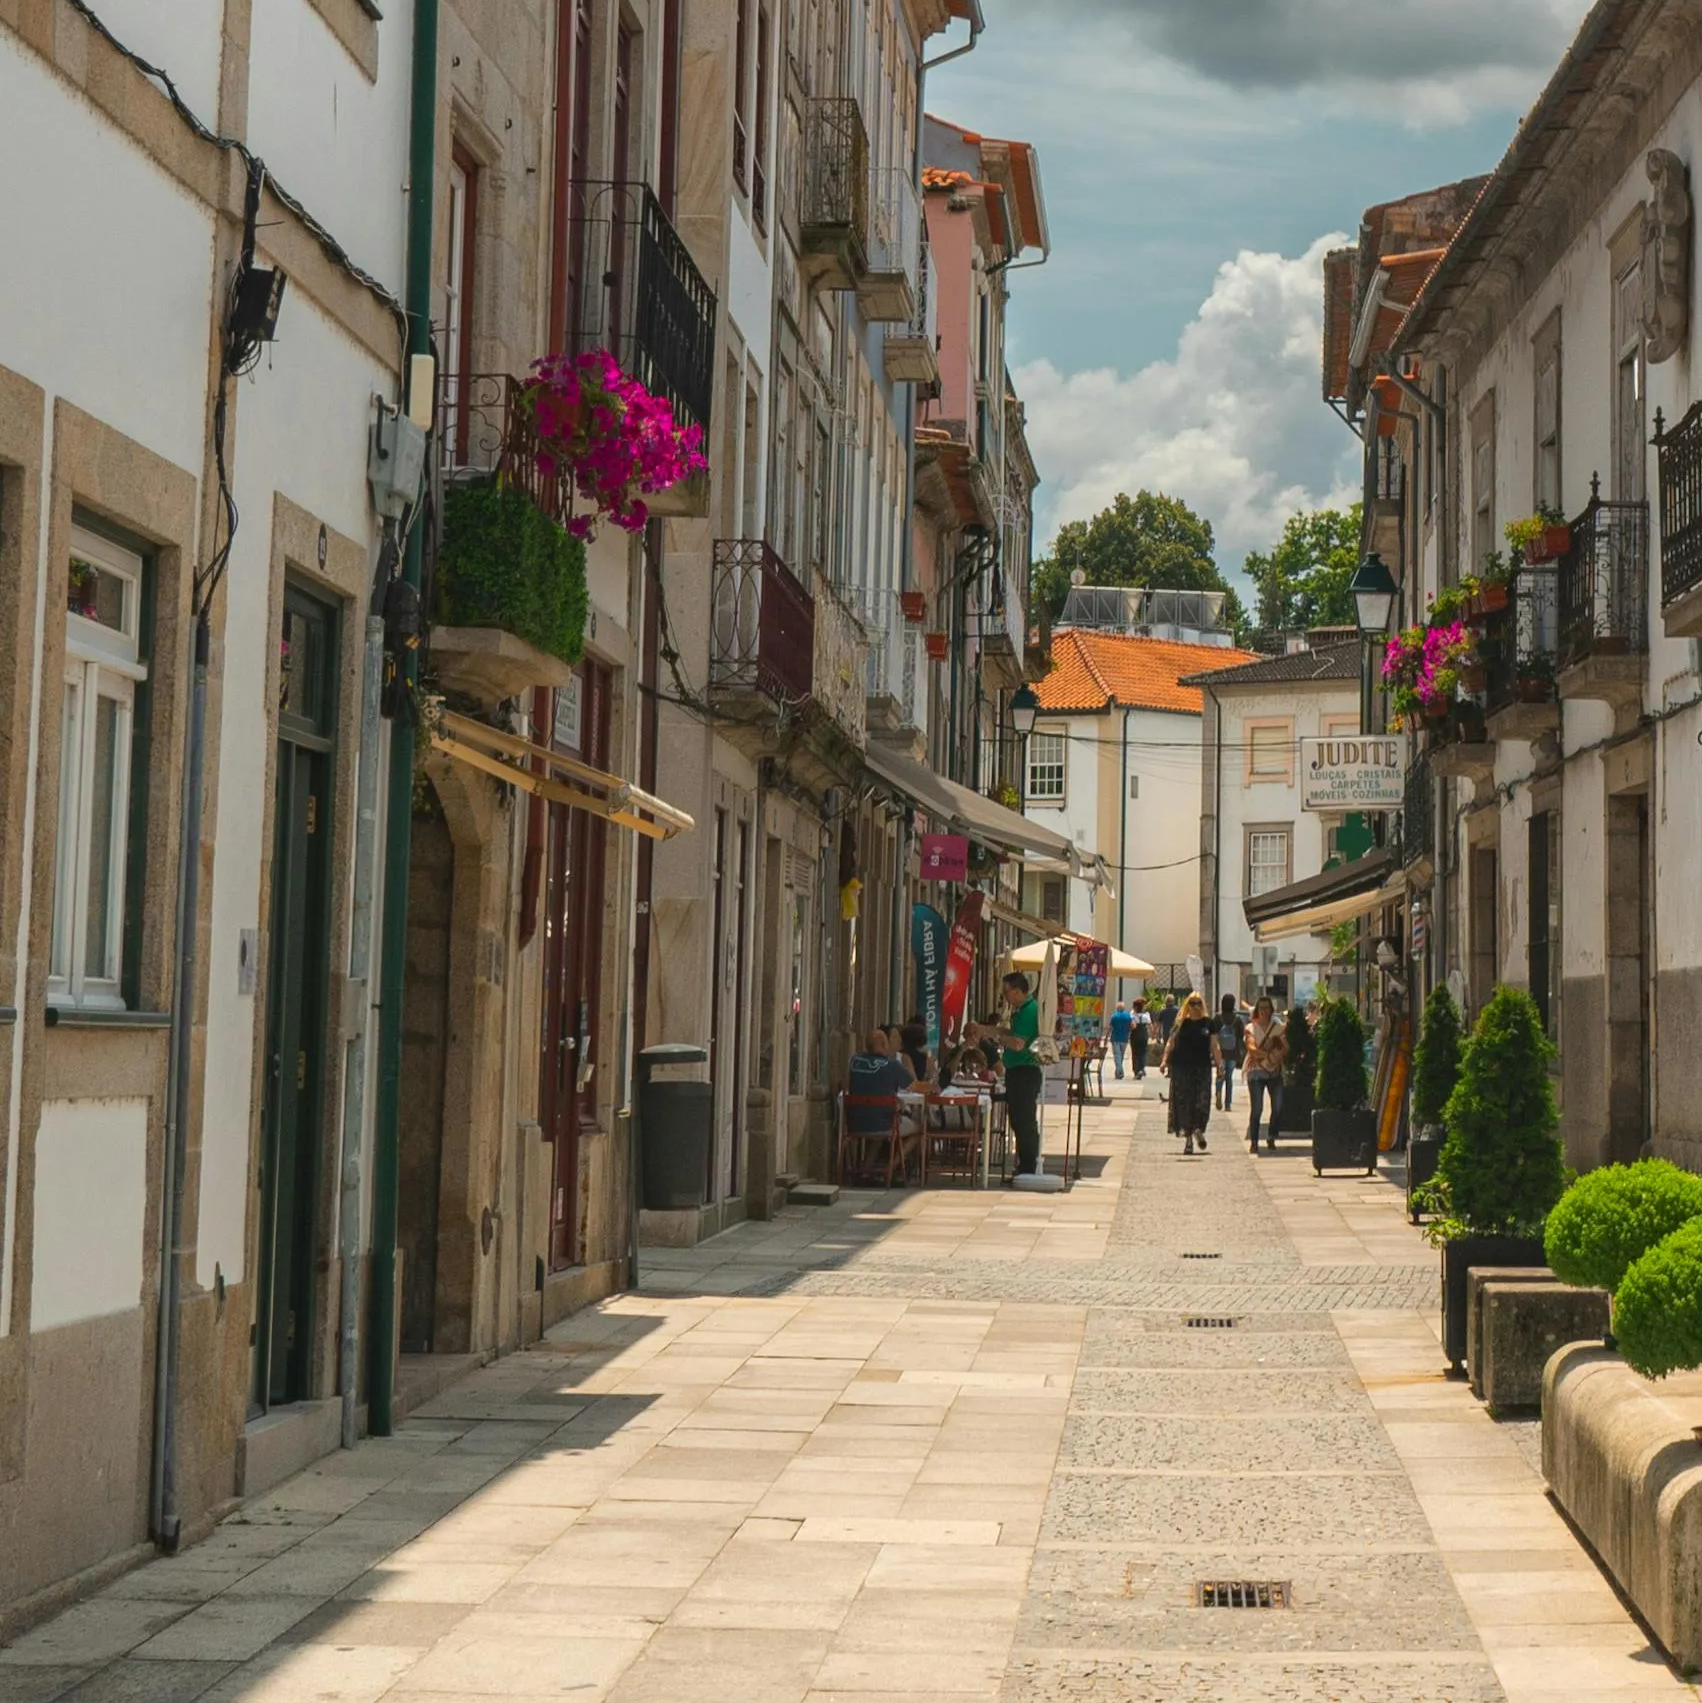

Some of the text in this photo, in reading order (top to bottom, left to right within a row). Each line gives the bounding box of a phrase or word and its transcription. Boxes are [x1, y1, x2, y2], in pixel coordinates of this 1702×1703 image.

[1311, 741, 1398, 770] JUDITE
[1309, 769, 1402, 781] LOUÇAS CRISTAIS
[1330, 779, 1381, 790] CARPETES
[1310, 789, 1400, 800] MÓVEIS COZINHAS
